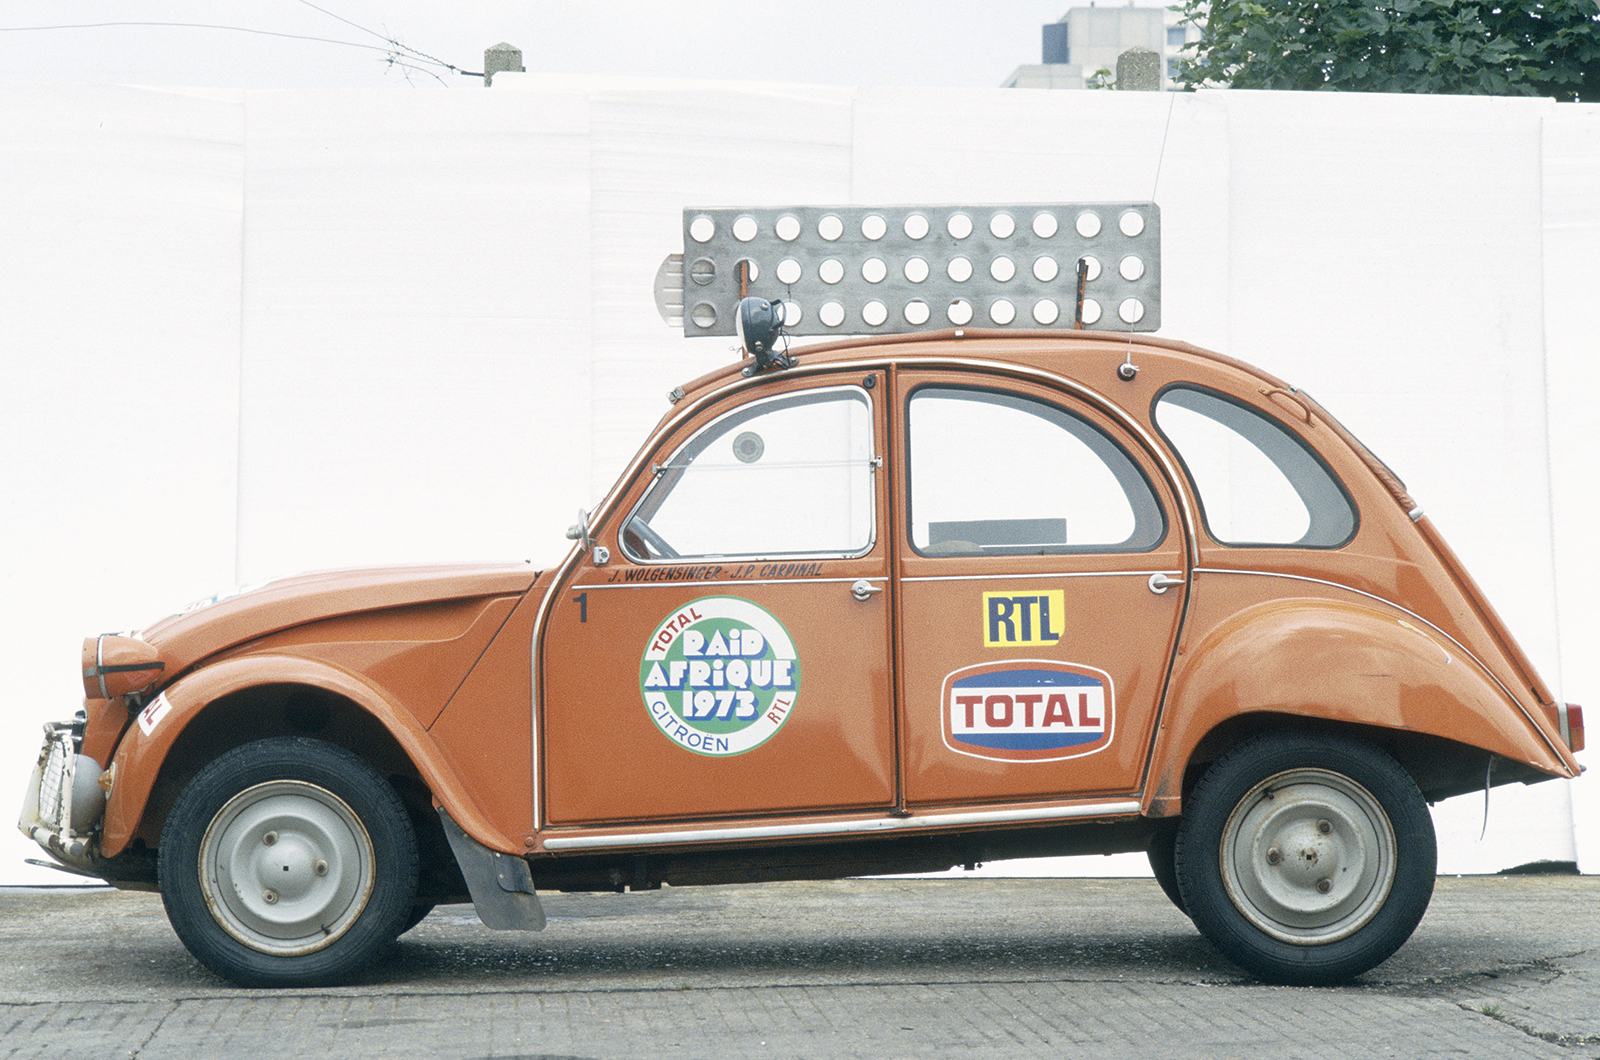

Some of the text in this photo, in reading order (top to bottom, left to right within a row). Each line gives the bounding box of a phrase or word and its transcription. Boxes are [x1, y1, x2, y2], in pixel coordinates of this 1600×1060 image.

[608, 569, 621, 583] J.
[625, 566, 723, 582] WOLGENSINGER
[759, 562, 824, 578] CARDINAL
[572, 592, 587, 623] 1
[988, 595, 1059, 642] RTL
[652, 607, 703, 653] TOTAL
[683, 690, 759, 722] 1973
[767, 698, 791, 725] RTL
[956, 693, 1101, 728] TOTAL
[652, 701, 729, 752] CITROËN
